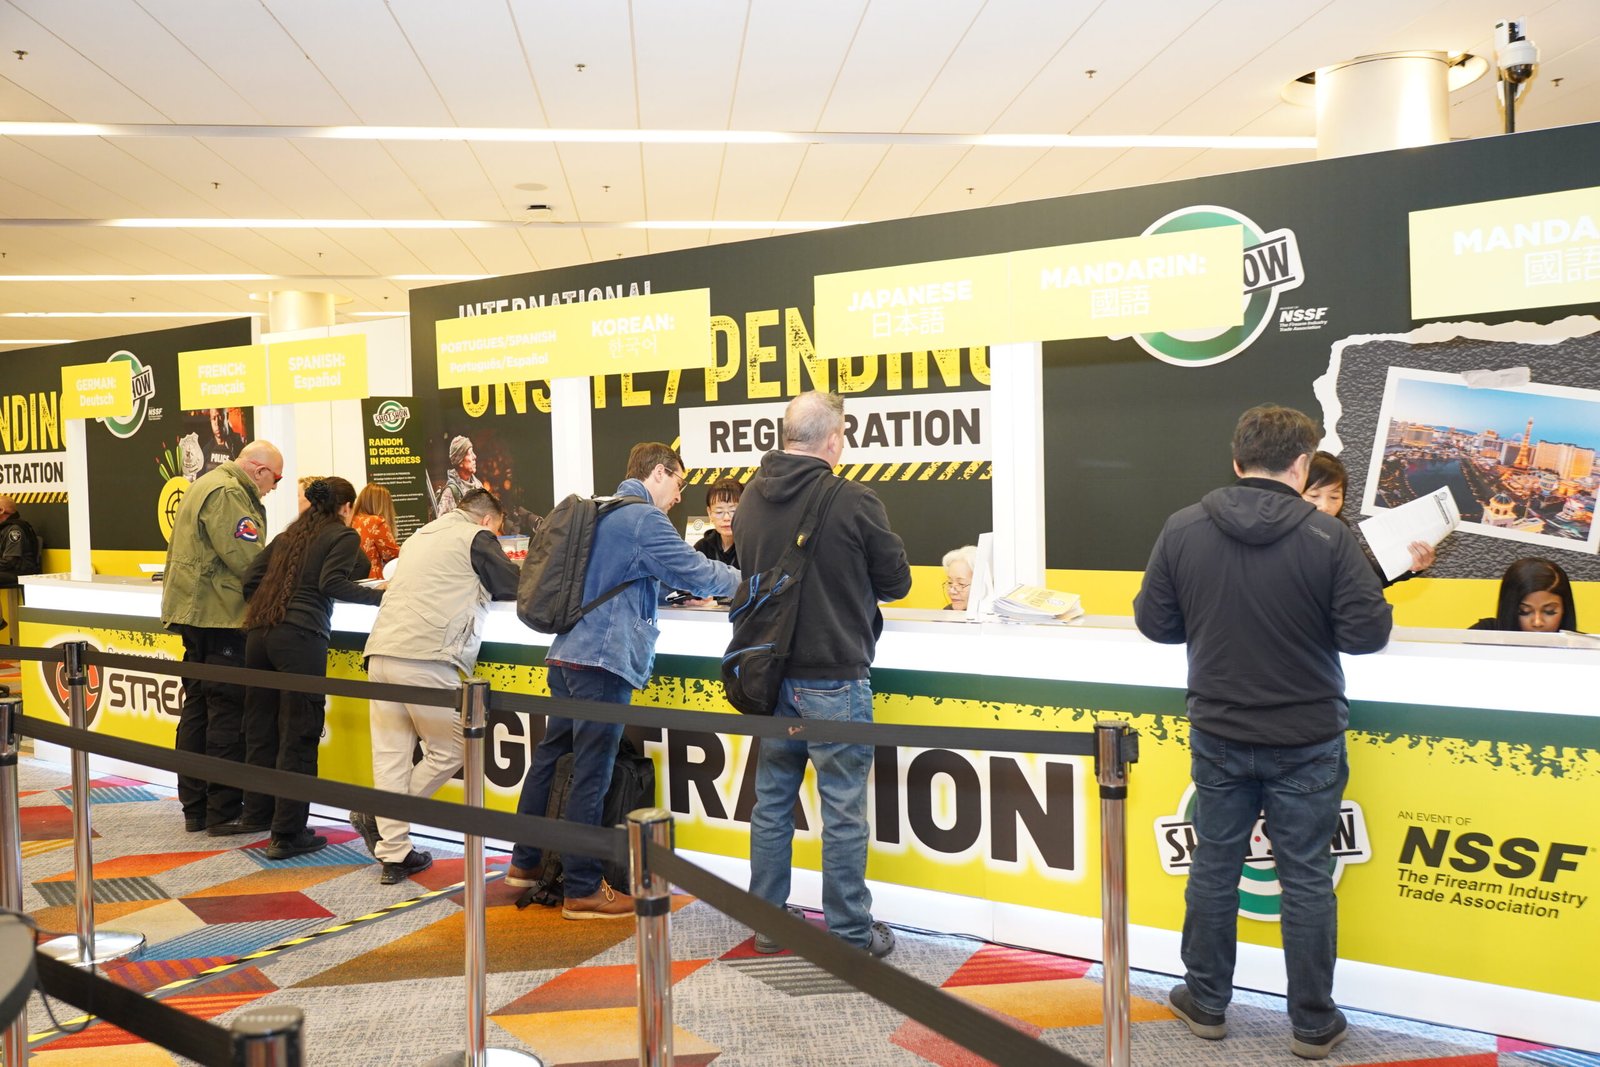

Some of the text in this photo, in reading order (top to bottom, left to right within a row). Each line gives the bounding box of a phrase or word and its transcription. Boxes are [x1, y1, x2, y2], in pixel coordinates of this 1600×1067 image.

[1041, 254, 1207, 289] MANDARIN:
[848, 280, 973, 312] JAPANESE
[1091, 286, 1151, 320] 國語
[872, 306, 945, 338] 日本語
[1279, 307, 1328, 323] NSSF
[591, 313, 675, 337] KOREAN:
[608, 335, 657, 360] 한국어
[198, 362, 246, 379] FRENCH:
[288, 354, 345, 372] SPANISH:
[76, 377, 117, 391] GERMAN:
[200, 380, 245, 397] Français
[294, 371, 341, 390] Español
[79, 394, 114, 407] Deutsch
[710, 407, 981, 454] REGIRATION
[369, 438, 403, 446] RANDOM
[369, 447, 410, 456] ID CHECKS
[370, 456, 421, 465] IN PROGRESS
[1398, 810, 1472, 826] AN EVENT OF
[1398, 825, 1588, 883] NSSF
[1398, 868, 1588, 909] The Firearm Industry
[1398, 884, 1559, 919] Trade Association
